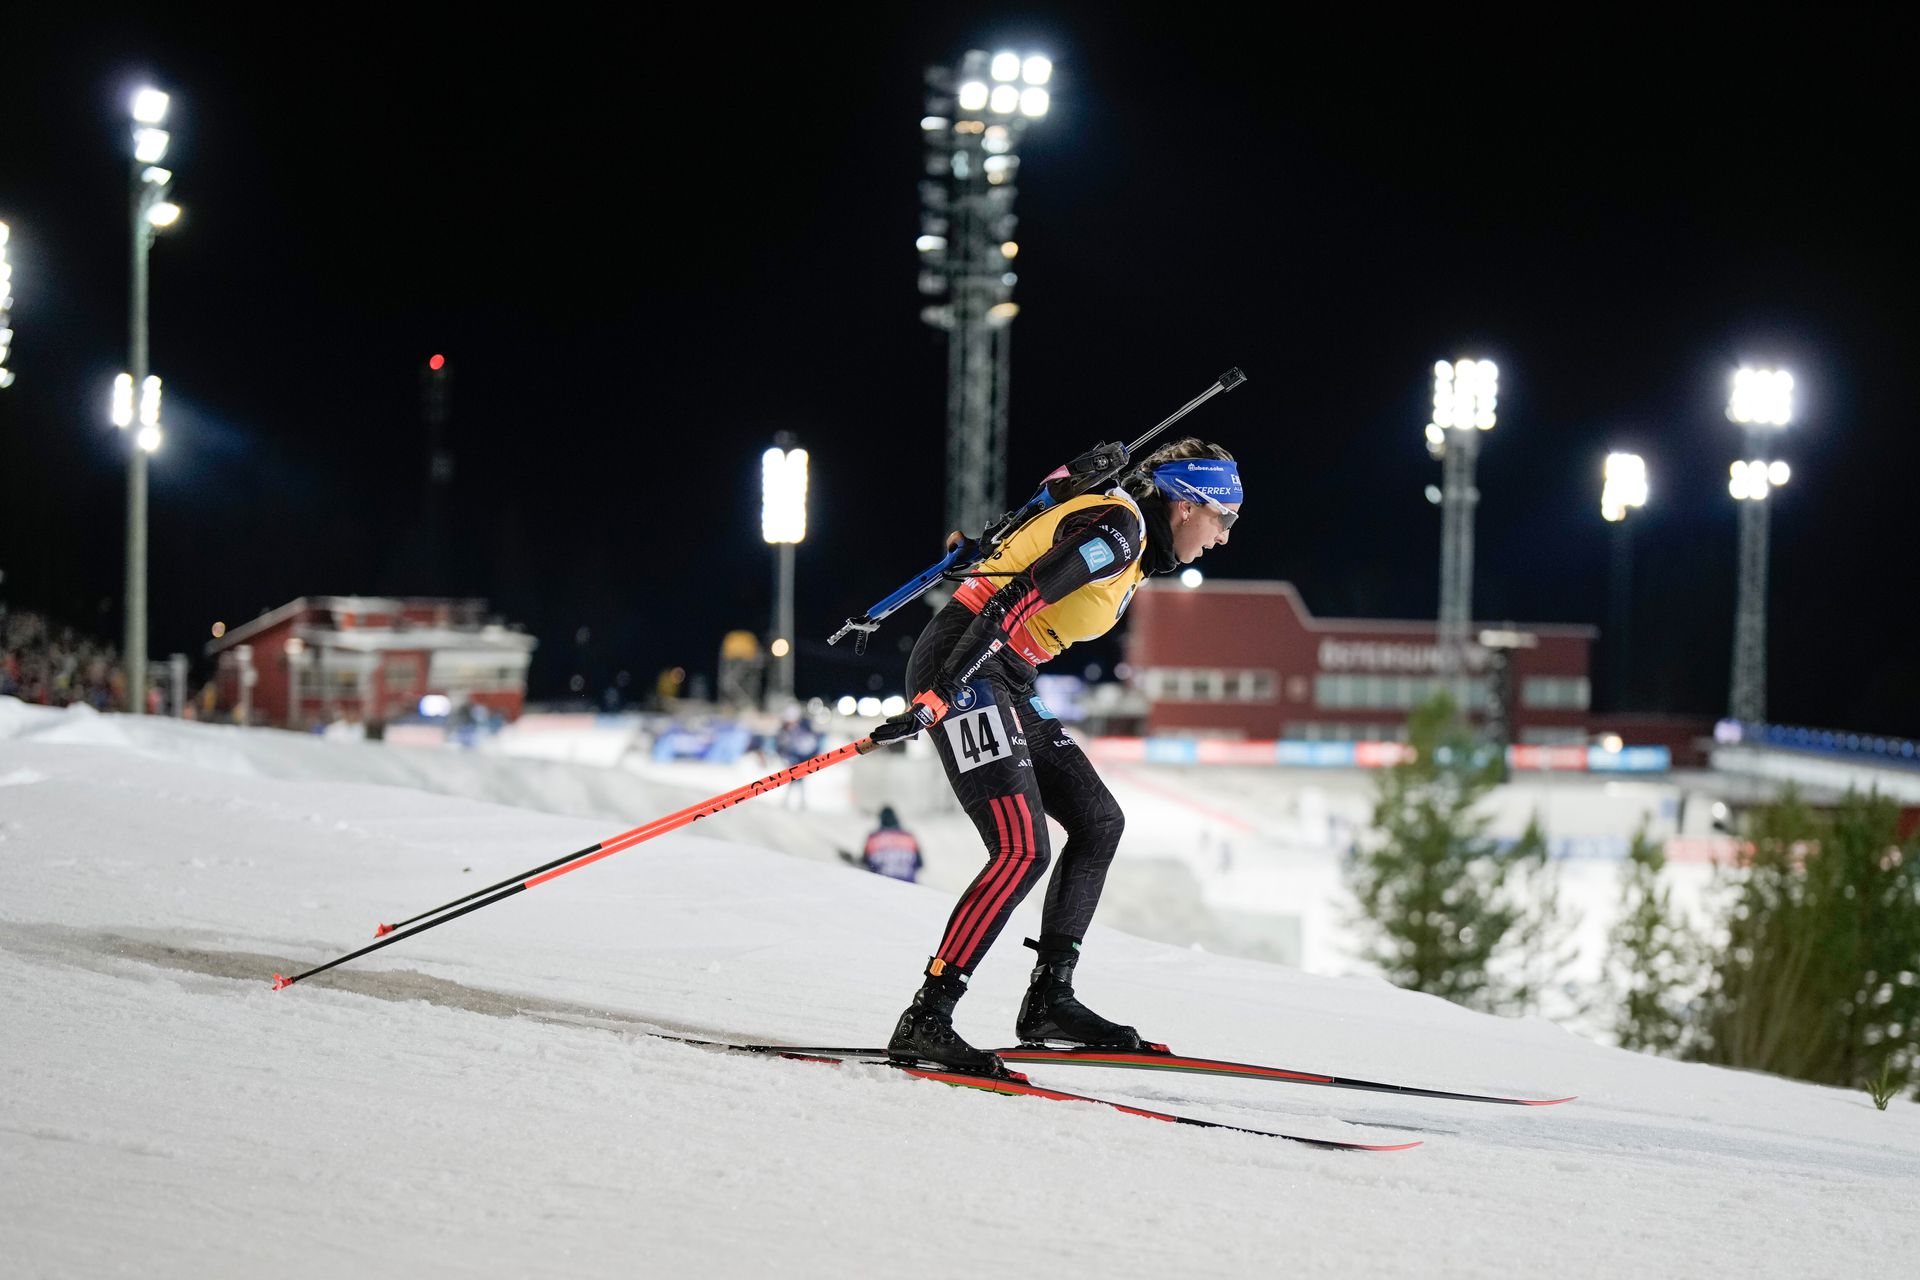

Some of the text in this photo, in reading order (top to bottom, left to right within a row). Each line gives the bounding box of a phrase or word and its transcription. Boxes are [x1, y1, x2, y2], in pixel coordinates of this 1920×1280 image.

[1110, 528, 1131, 561] TERREX
[961, 649, 993, 683] Kaufland
[960, 712, 999, 763] 44
